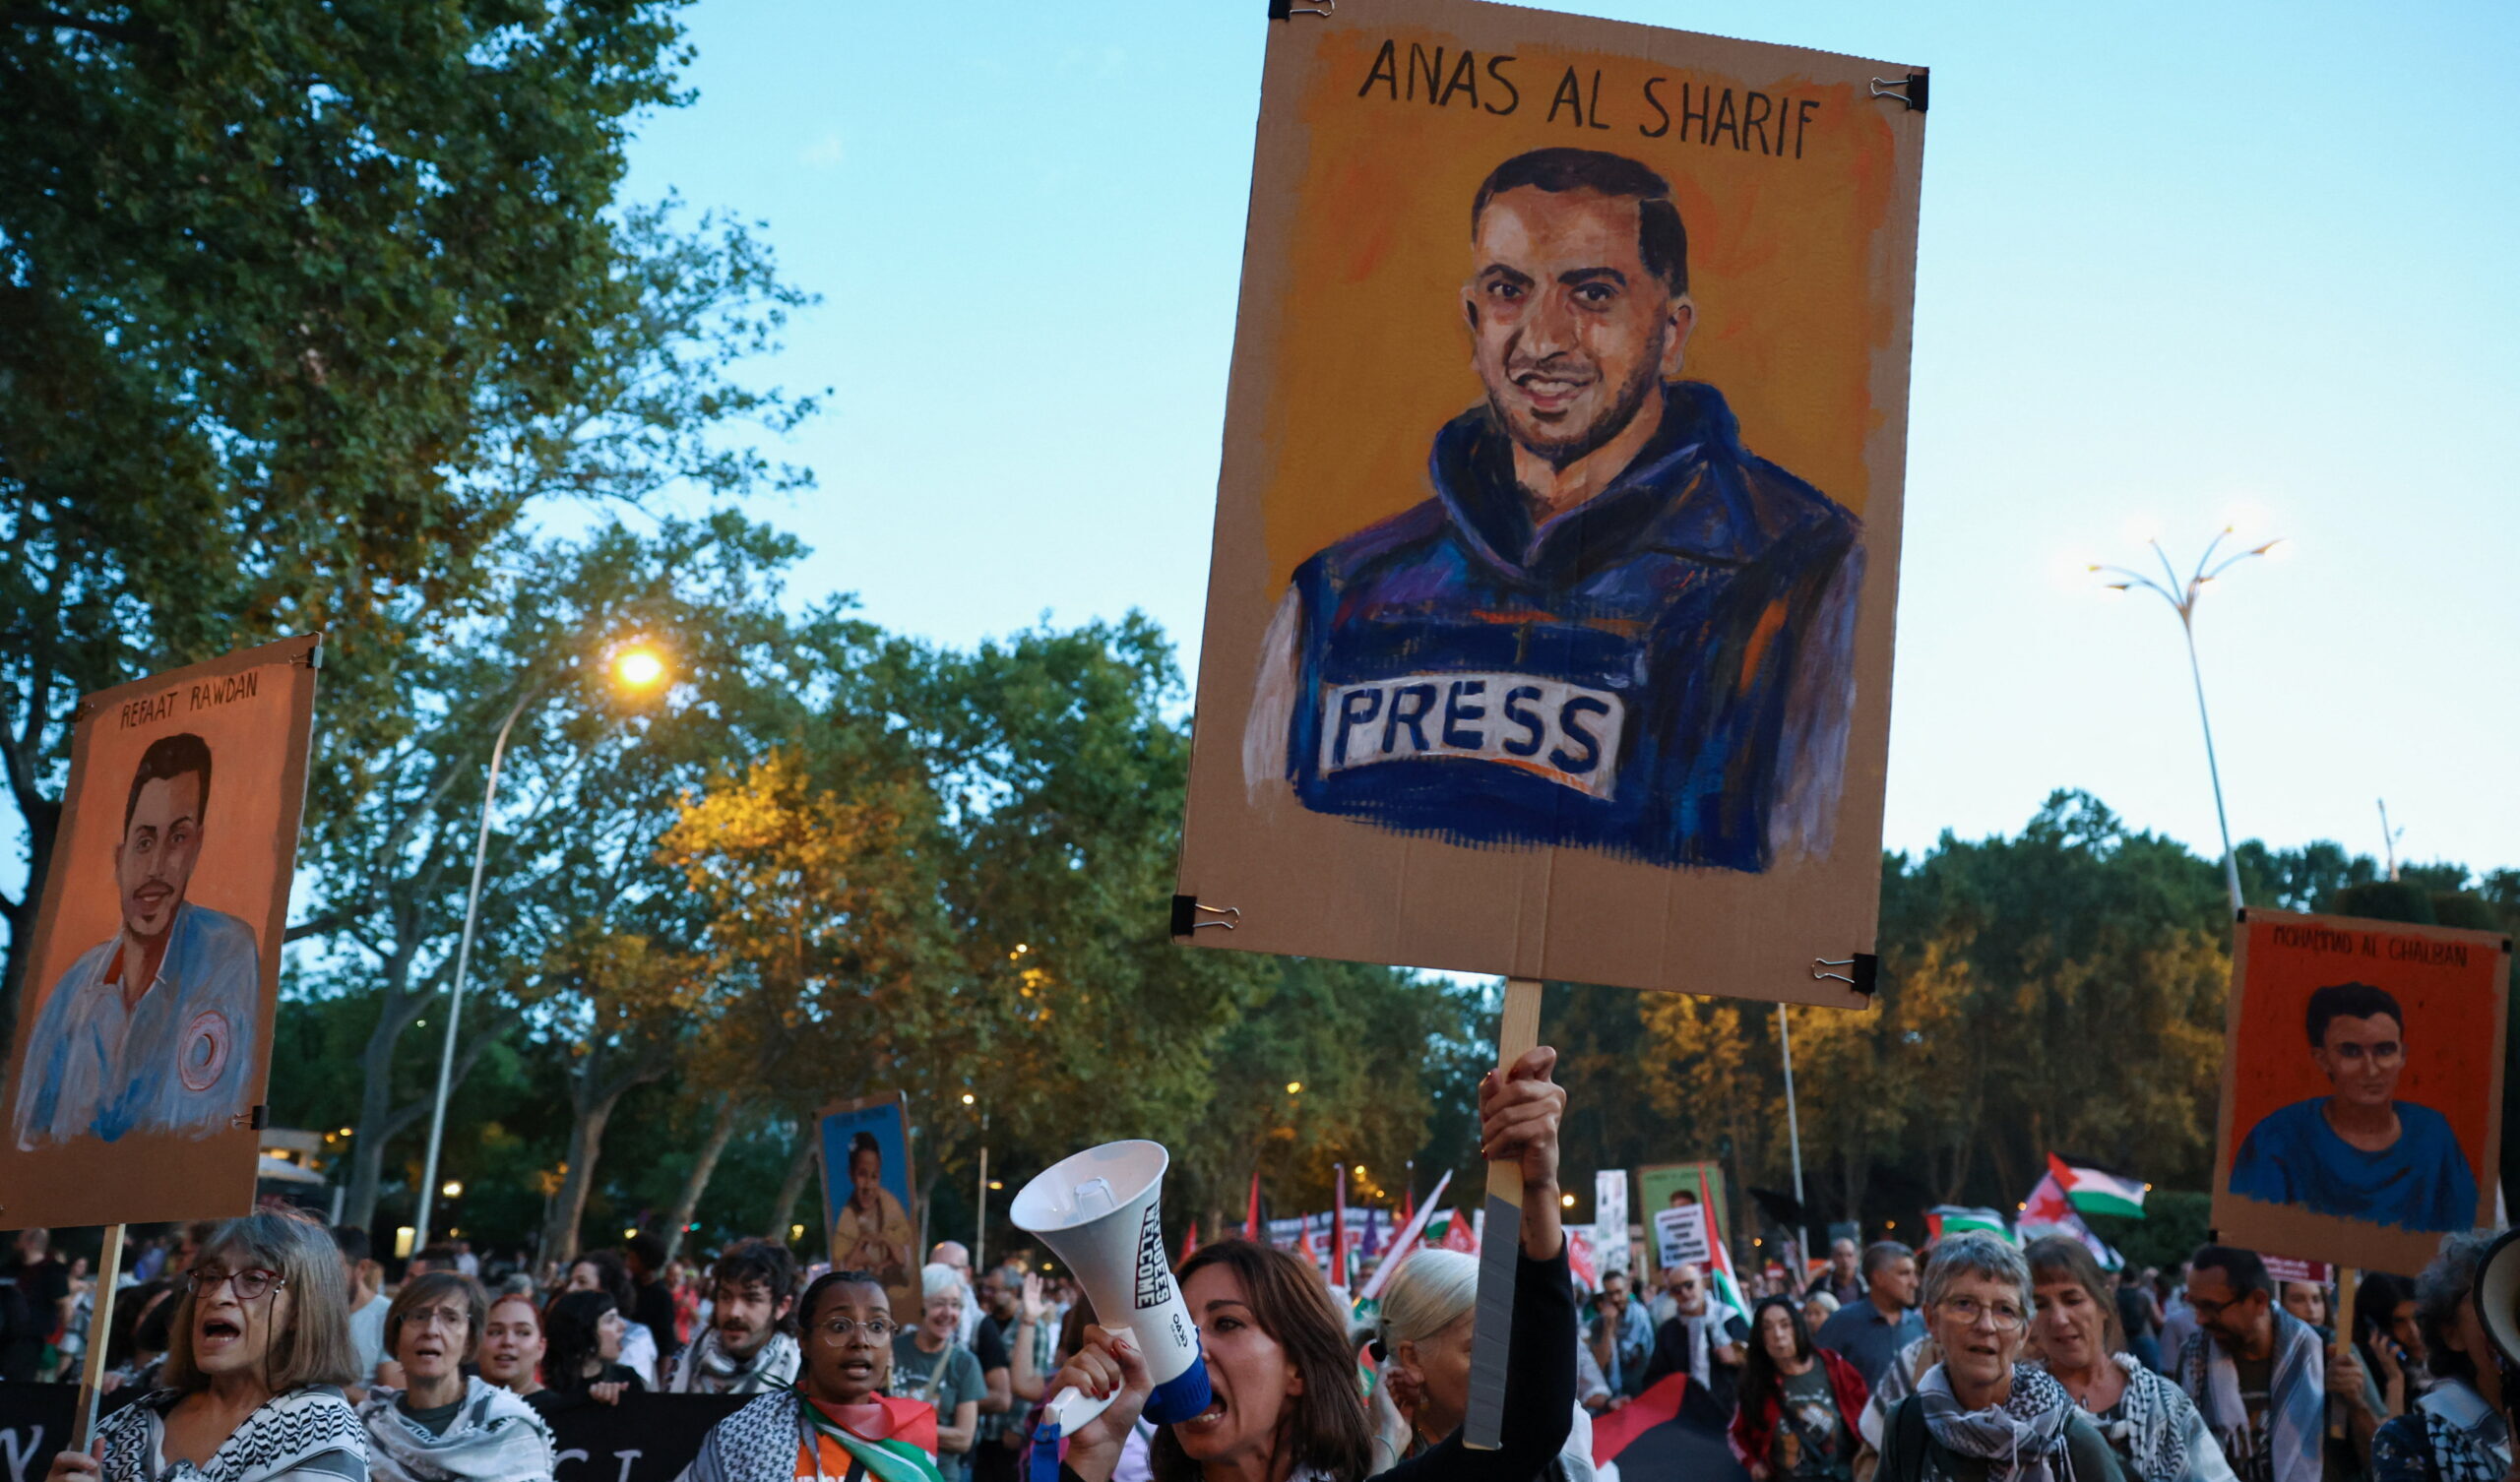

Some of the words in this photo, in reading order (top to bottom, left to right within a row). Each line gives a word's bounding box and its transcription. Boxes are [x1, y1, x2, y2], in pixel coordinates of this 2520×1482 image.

[1357, 38, 1520, 116] ANAS
[1546, 65, 1611, 130] AL
[1638, 77, 1821, 160] SHARIF
[119, 691, 179, 730] REFAAT
[189, 671, 259, 712] RAWDAN
[1332, 679, 1610, 774] PRESS
[1137, 1207, 1157, 1309] WELCOME
